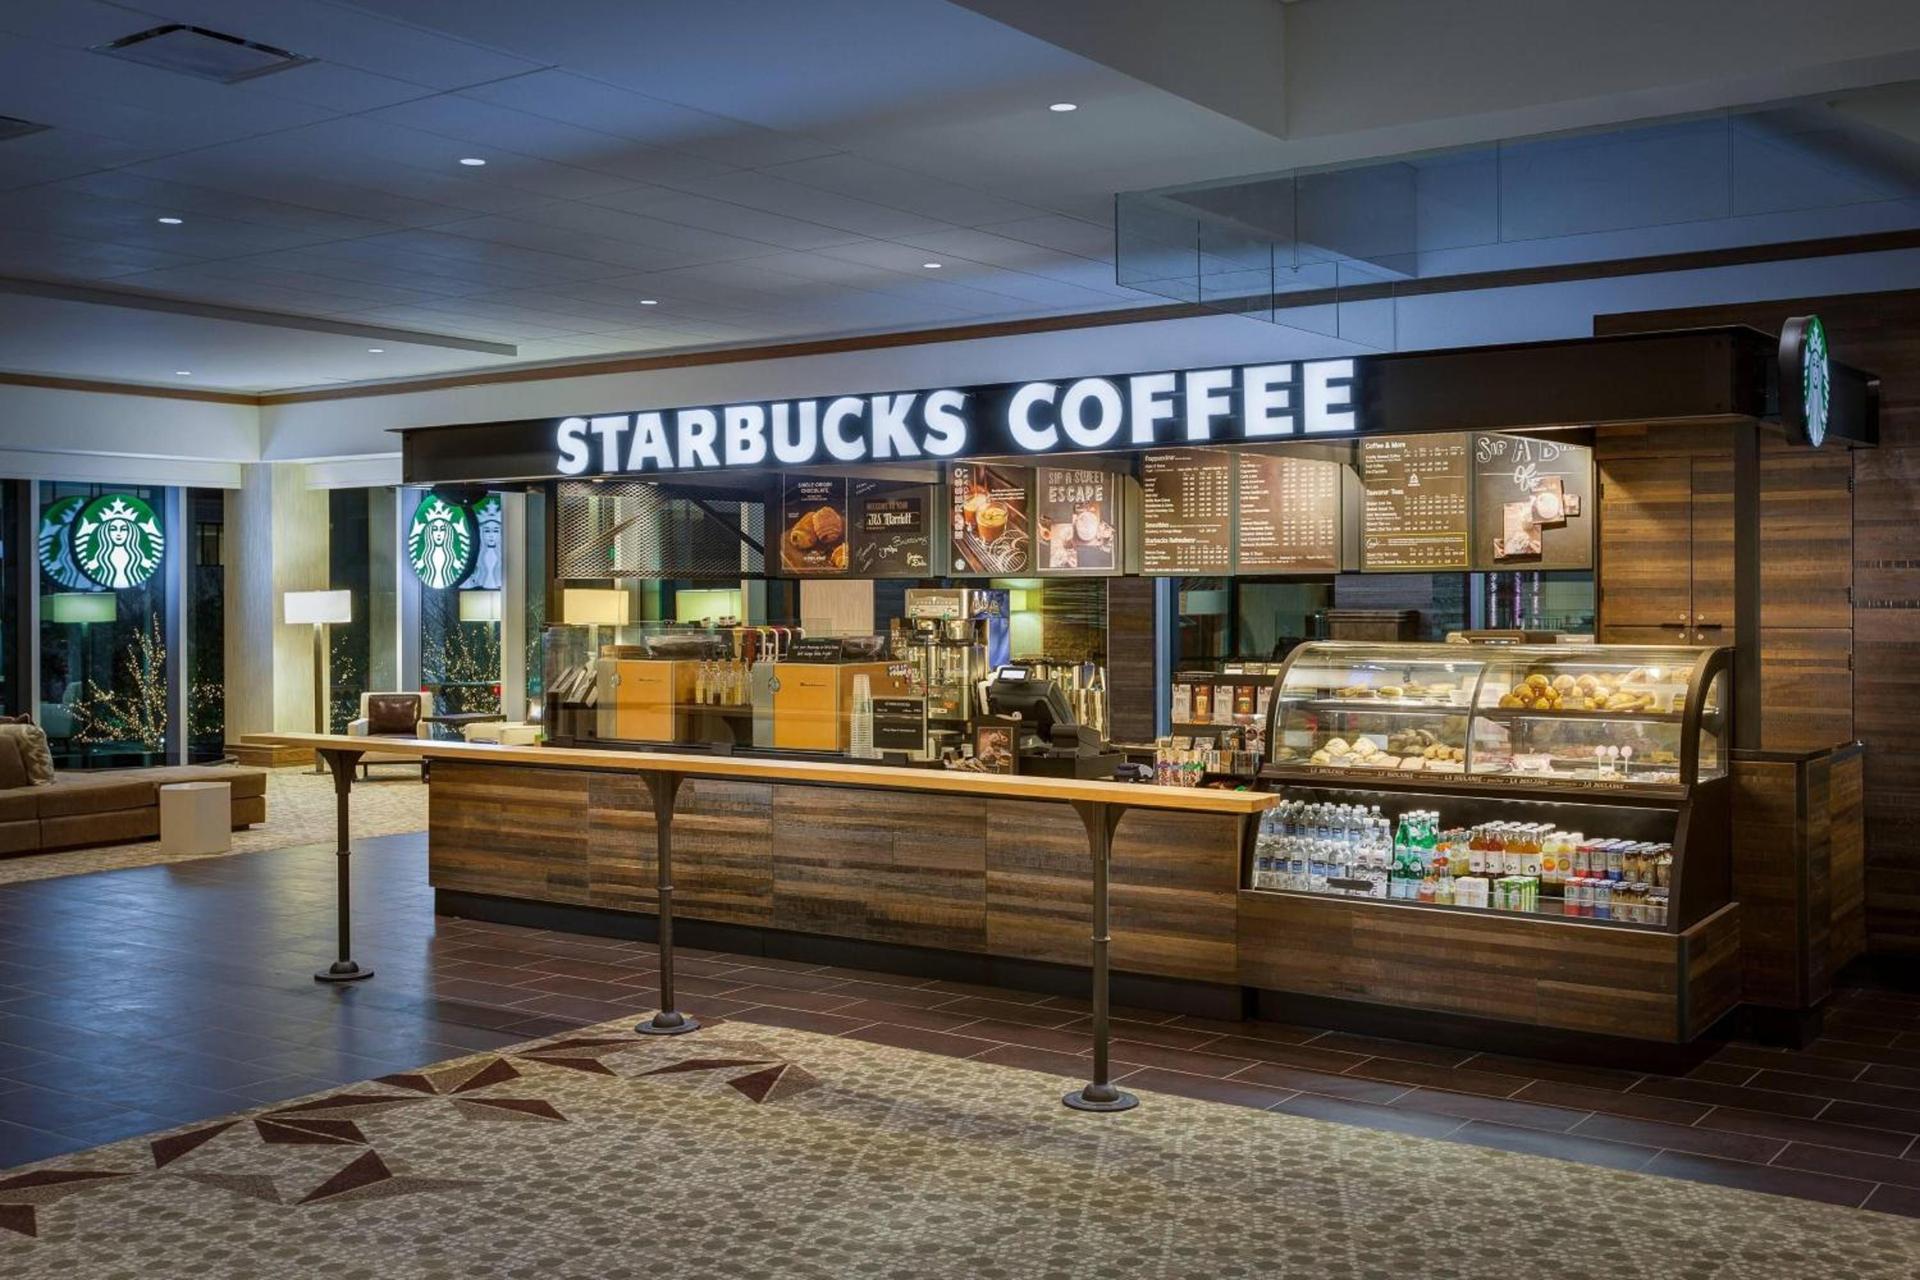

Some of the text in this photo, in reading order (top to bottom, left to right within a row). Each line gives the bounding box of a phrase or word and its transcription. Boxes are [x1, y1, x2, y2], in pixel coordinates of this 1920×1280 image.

[556, 359, 1355, 476] STARBUCKS COFFEE
[1511, 438, 1532, 463] A
[1049, 470, 1104, 485] SIP A SWEET
[954, 468, 964, 540] ESPRESSO
[1049, 484, 1103, 503] ESCAPE
[883, 512, 912, 526] Marriott
